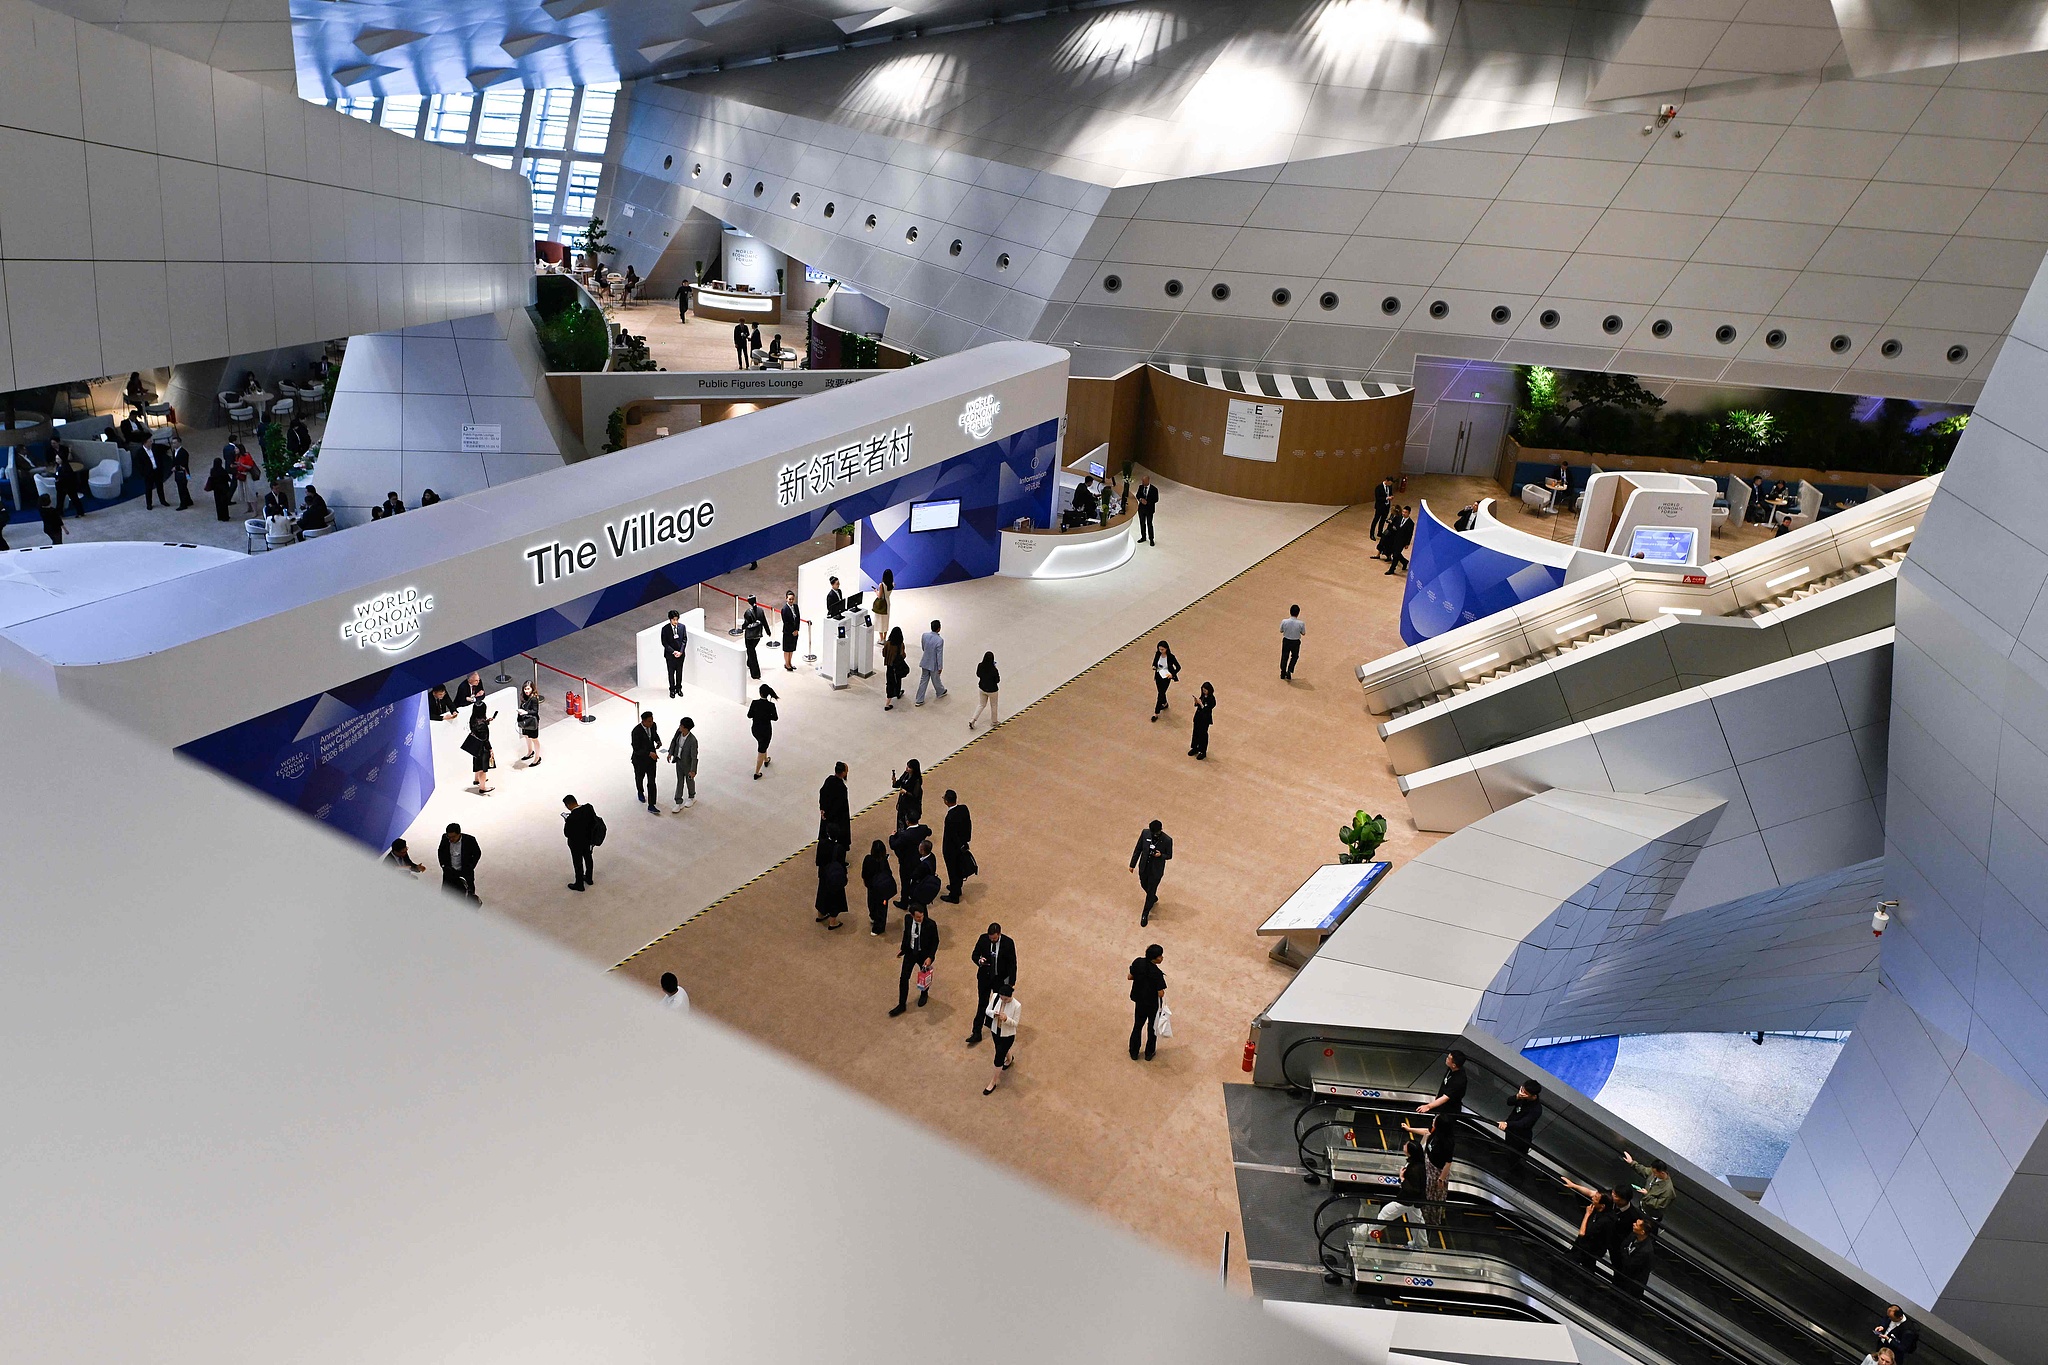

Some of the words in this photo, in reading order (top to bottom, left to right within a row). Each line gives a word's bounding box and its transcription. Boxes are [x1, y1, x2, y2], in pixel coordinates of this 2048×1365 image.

[698, 379, 728, 388] Public
[731, 379, 766, 389] Figures
[768, 379, 804, 388] Lounge
[1255, 405, 1264, 416] E
[778, 424, 914, 507] 新领军者村
[1019, 470, 1047, 485] Information
[526, 541, 597, 585] The
[606, 501, 716, 559] Village
[356, 589, 417, 617] WORLD
[344, 597, 434, 638] ECONOMIC
[361, 618, 420, 648] FORUM
[320, 724, 342, 745] Annual
[321, 740, 335, 754] New
[335, 717, 367, 744] Champions
[275, 753, 310, 777] ECONOMIC
[280, 751, 304, 768] WORLD
[321, 748, 338, 765] 2026
[282, 763, 305, 780] FORUM
